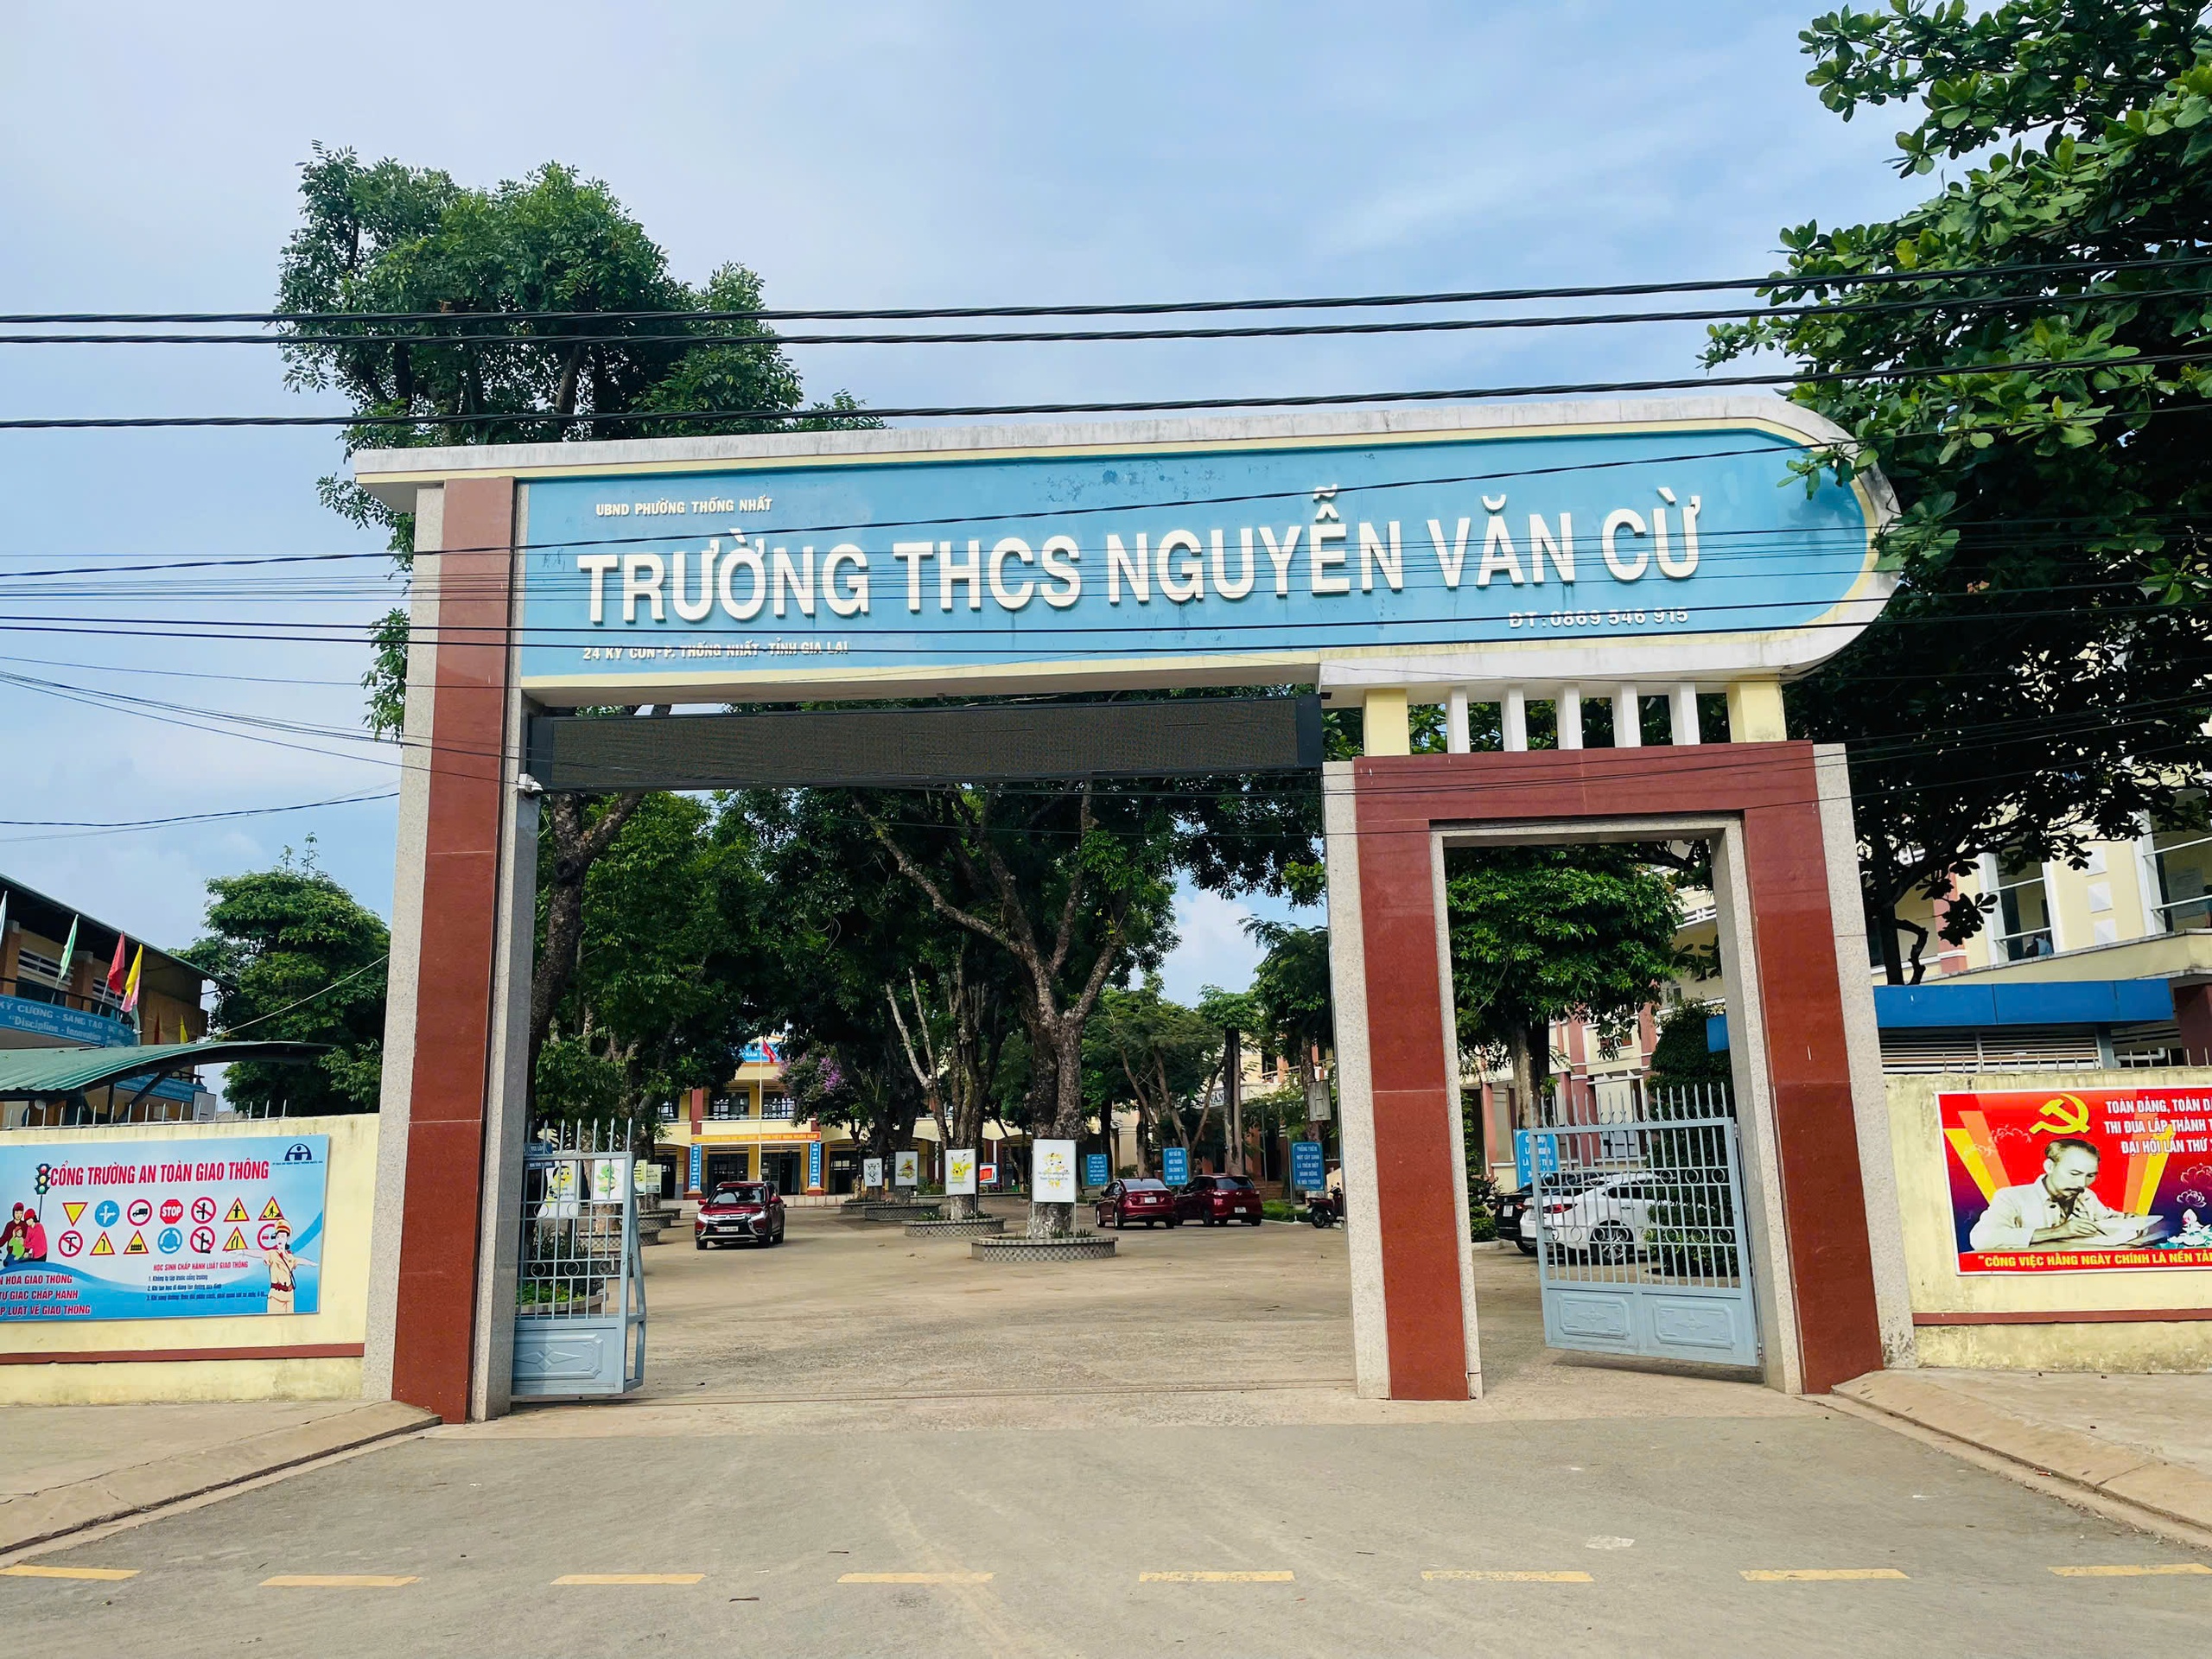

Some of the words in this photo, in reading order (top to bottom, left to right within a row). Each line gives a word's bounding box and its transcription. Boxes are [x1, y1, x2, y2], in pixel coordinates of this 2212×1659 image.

[596, 503, 630, 516] UBND
[634, 498, 686, 516] PHƯỜNG
[691, 497, 734, 514] THỐNG
[739, 494, 772, 512] NHẤT
[577, 528, 869, 625] TRƯỜNG
[893, 535, 1082, 613] THCS
[1107, 484, 1404, 606] NGUYỄN
[1427, 494, 1575, 588] VĂN
[1601, 486, 1701, 582] CỪ
[1608, 608, 1646, 625] 546
[1654, 607, 1688, 623] 915
[583, 647, 601, 660] 24
[681, 640, 721, 658] THỐNG
[801, 641, 823, 655] GIA
[827, 640, 849, 655] LAI
[2105, 1097, 2135, 1114] TOÀN
[2137, 1096, 2171, 1114] ĐẢNG,
[2172, 1096, 2201, 1112] TOÀN
[2103, 1121, 2122, 1134] THI
[2124, 1120, 2145, 1134] ĐUA
[2147, 1116, 2168, 1135] LẬP
[2171, 1116, 2207, 1132] THÀNH
[2121, 1141, 2140, 1157] ĐẠI
[2143, 1137, 2161, 1156] HỘI
[2163, 1135, 2185, 1153] LẦN
[2186, 1136, 2208, 1152] THỨ
[50, 1160, 84, 1186] CỔNG
[87, 1162, 135, 1185] TRƯỜNG
[139, 1165, 156, 1184] AN
[161, 1160, 192, 1183] TOÀN
[195, 1162, 225, 1181] GIAO
[229, 1158, 270, 1180] THÔNG
[162, 1205, 182, 1217] STOP
[153, 1263, 163, 1272] HỌC
[2018, 1255, 2044, 1268] VIỆC
[2081, 1252, 2111, 1265] NGÀY
[2114, 1252, 2150, 1265] CHÍNH
[2152, 1251, 2167, 1263] LÀ
[24, 1274, 43, 1284] GIAO
[46, 1273, 73, 1284] THÔNG
[10, 1288, 29, 1300] GIÁC
[31, 1287, 54, 1300] CHẤP
[55, 1288, 79, 1299] HÀNH
[8, 1306, 28, 1318] LUẬT
[42, 1306, 61, 1315] GIAO
[64, 1303, 91, 1314] THÔNG
